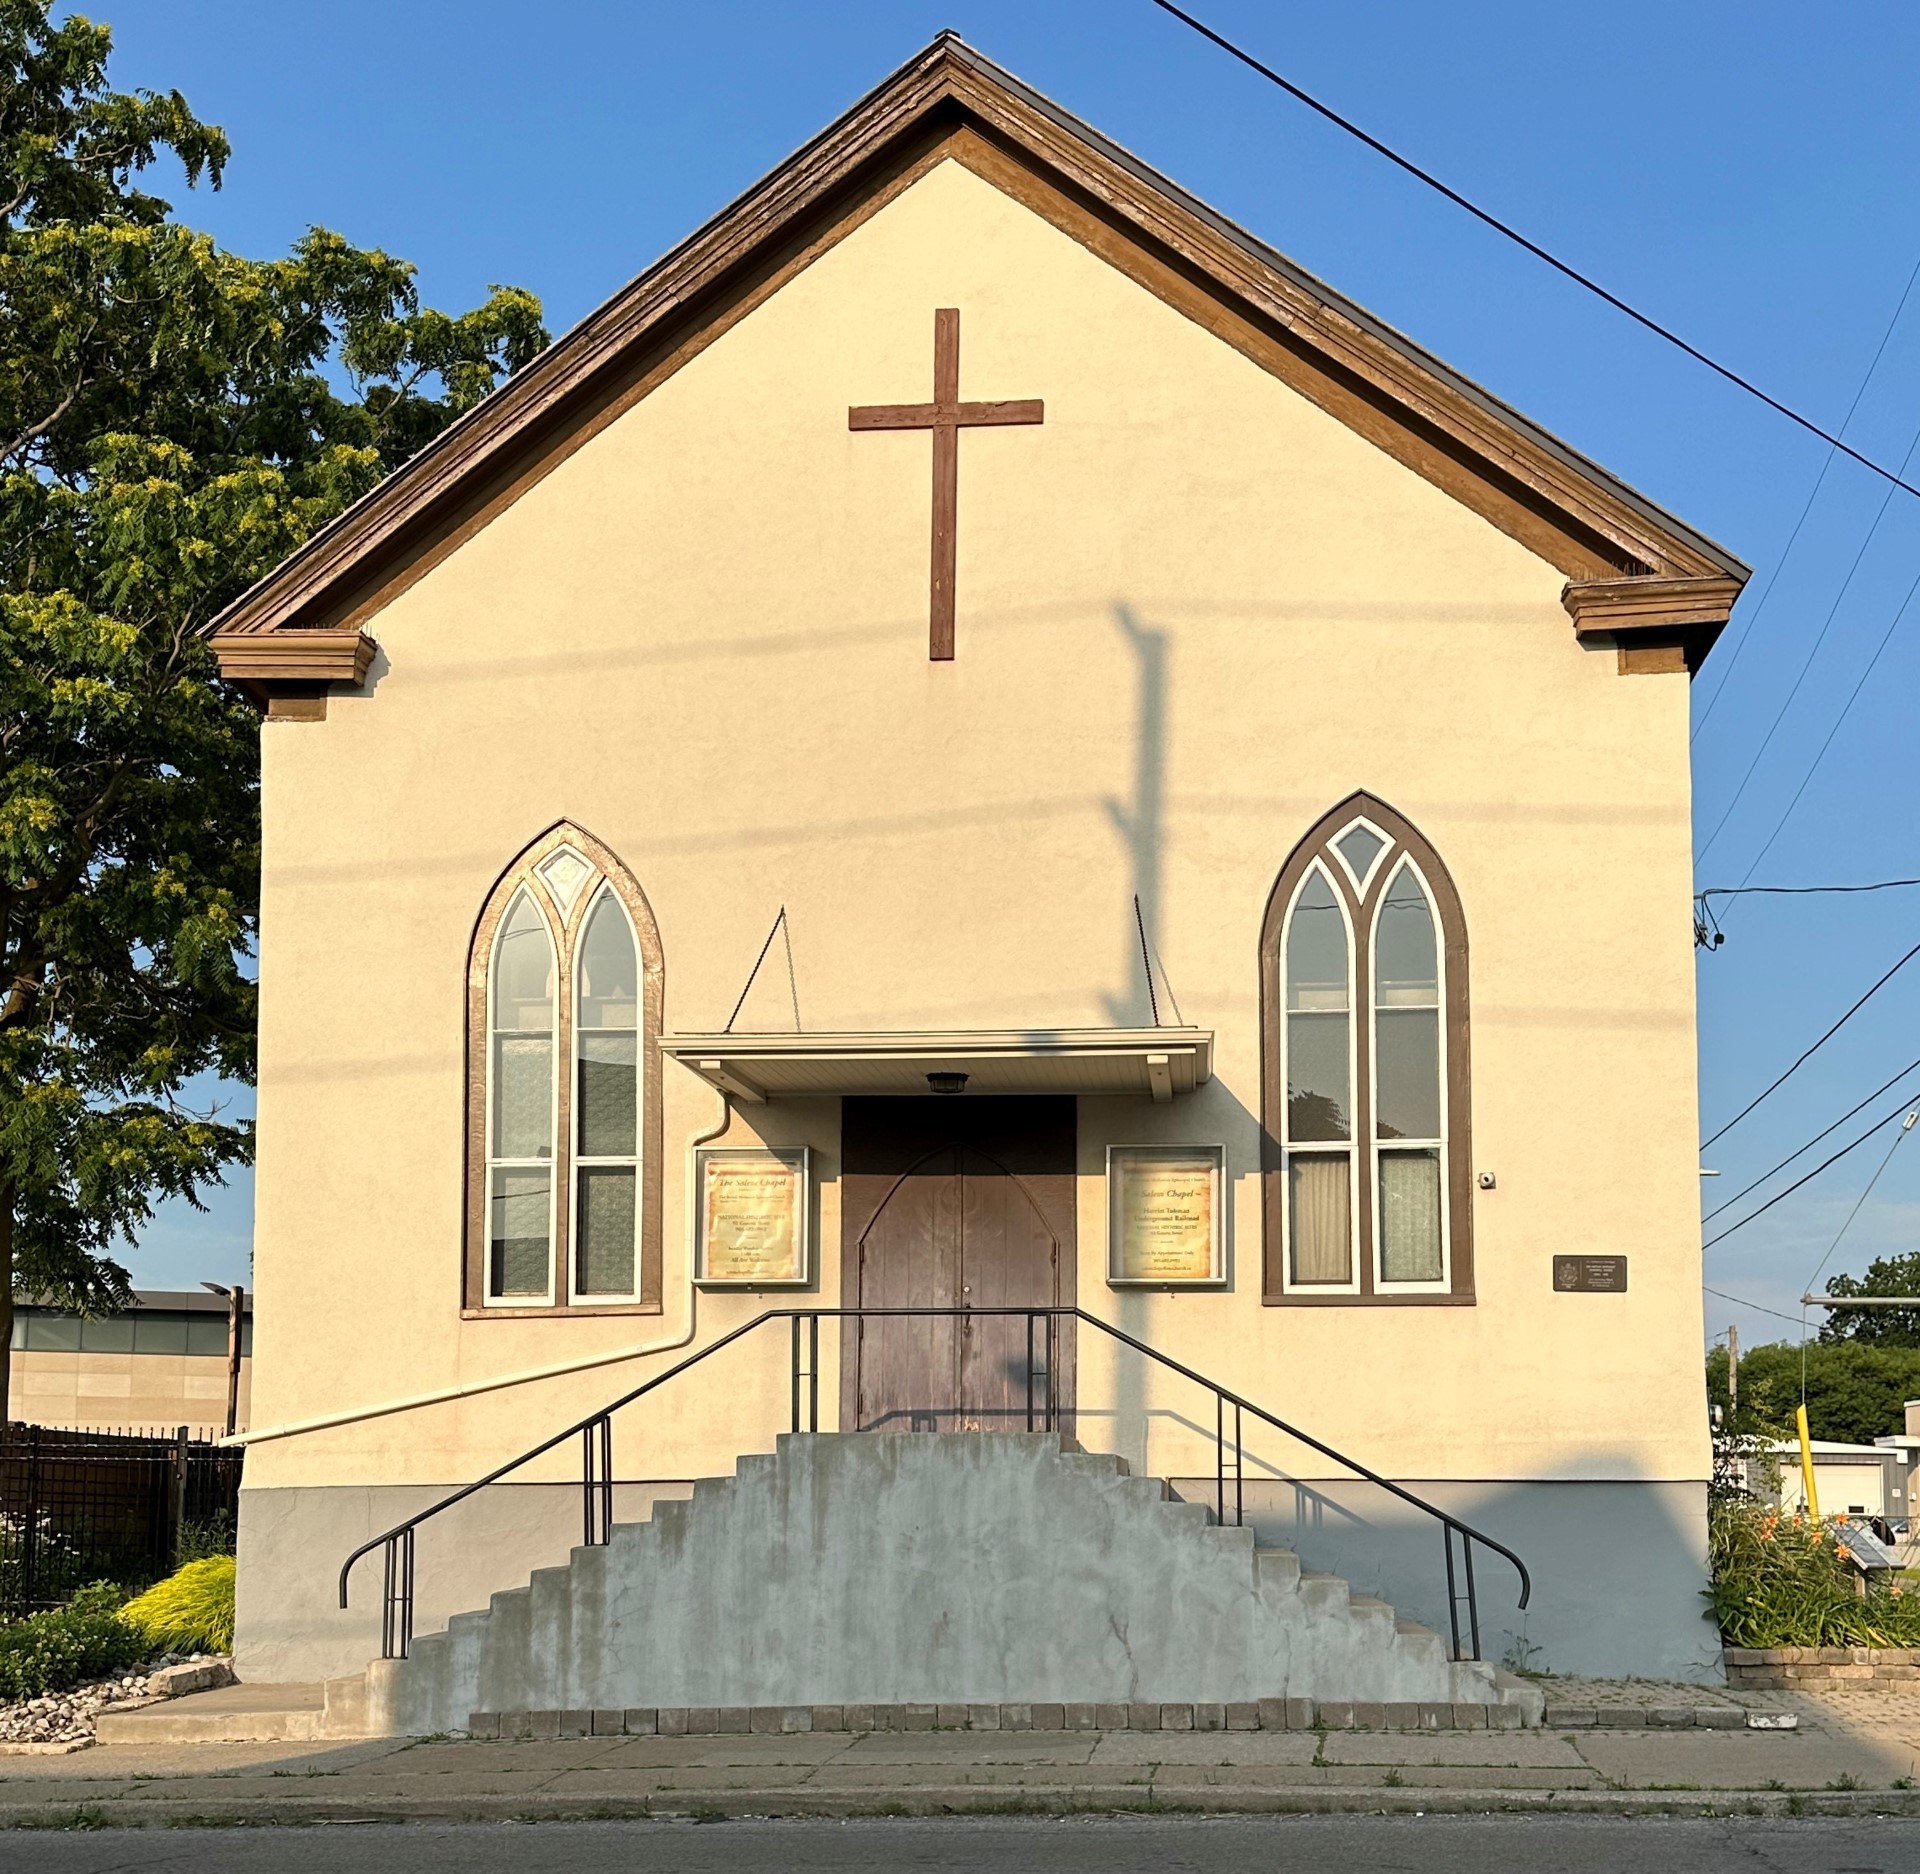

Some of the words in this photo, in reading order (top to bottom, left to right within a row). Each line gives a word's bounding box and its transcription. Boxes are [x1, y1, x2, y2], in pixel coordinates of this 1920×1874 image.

[719, 1178, 733, 1186] The
[760, 1178, 787, 1188] Chapel
[1142, 1189, 1164, 1197] Salem
[1166, 1189, 1194, 1199] Chapel
